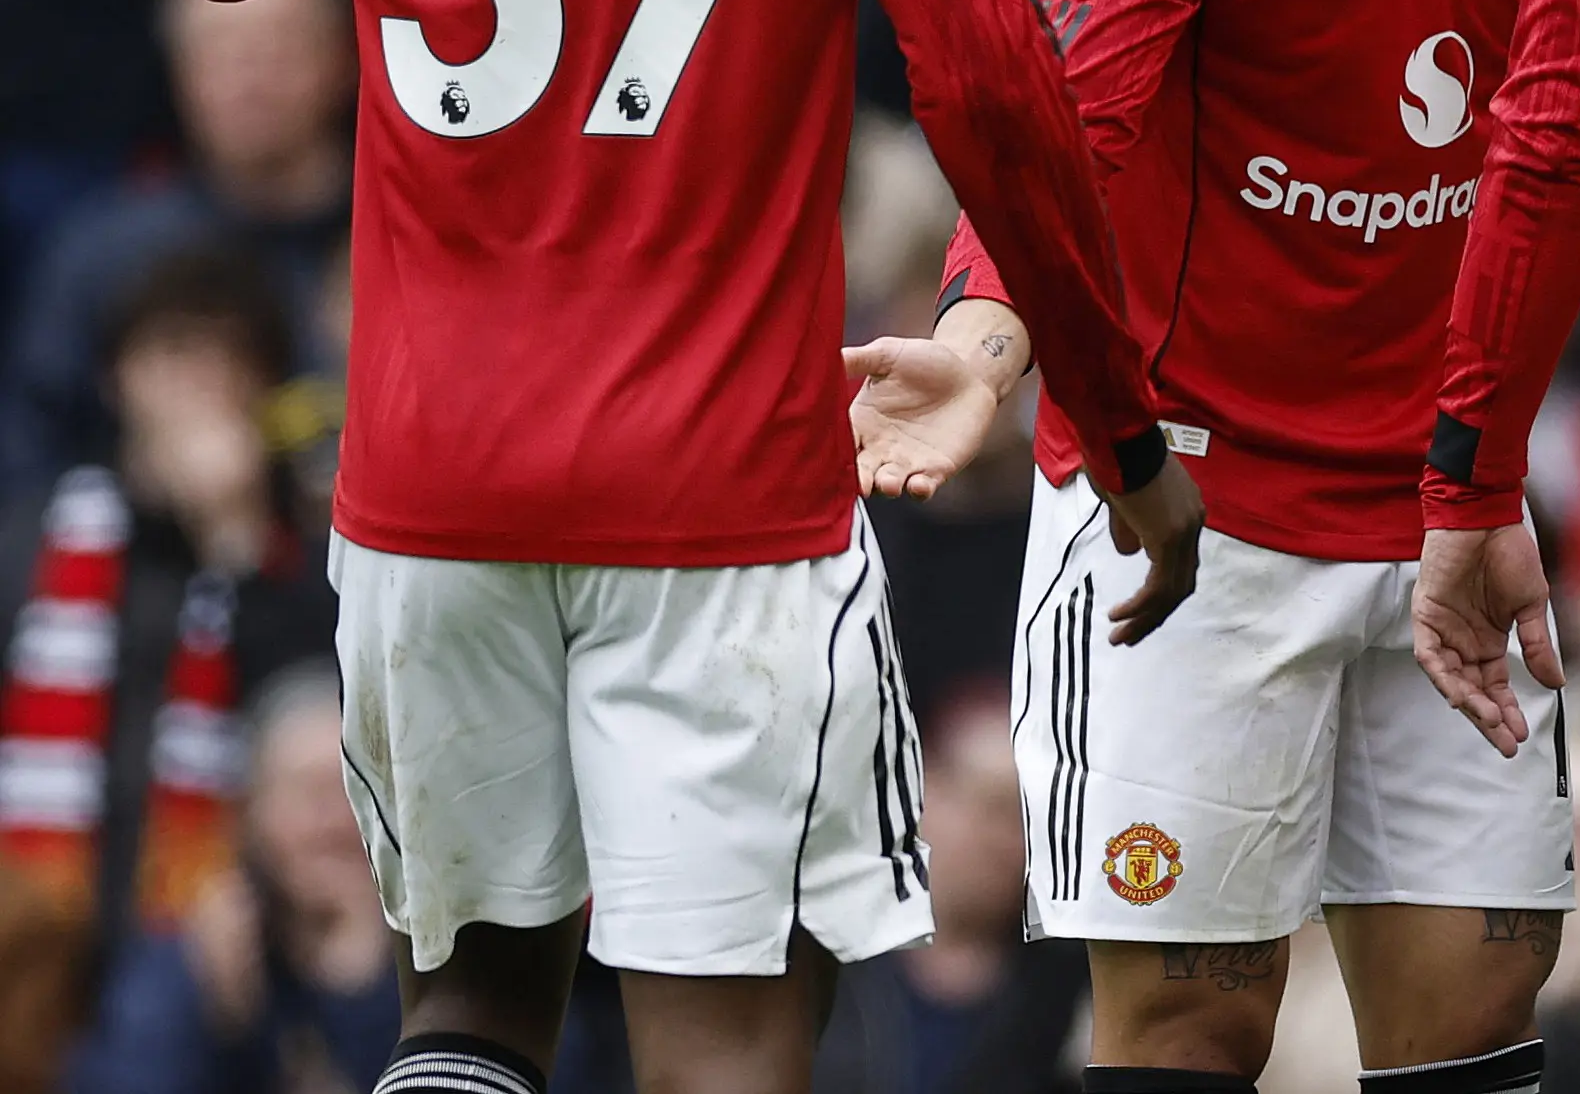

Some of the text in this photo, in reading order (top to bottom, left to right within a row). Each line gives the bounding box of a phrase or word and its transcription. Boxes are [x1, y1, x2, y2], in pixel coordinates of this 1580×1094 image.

[1240, 156, 1482, 243] Snapdra
[1111, 828, 1174, 856] MANCHESTER
[1119, 886, 1164, 899] UNITED
